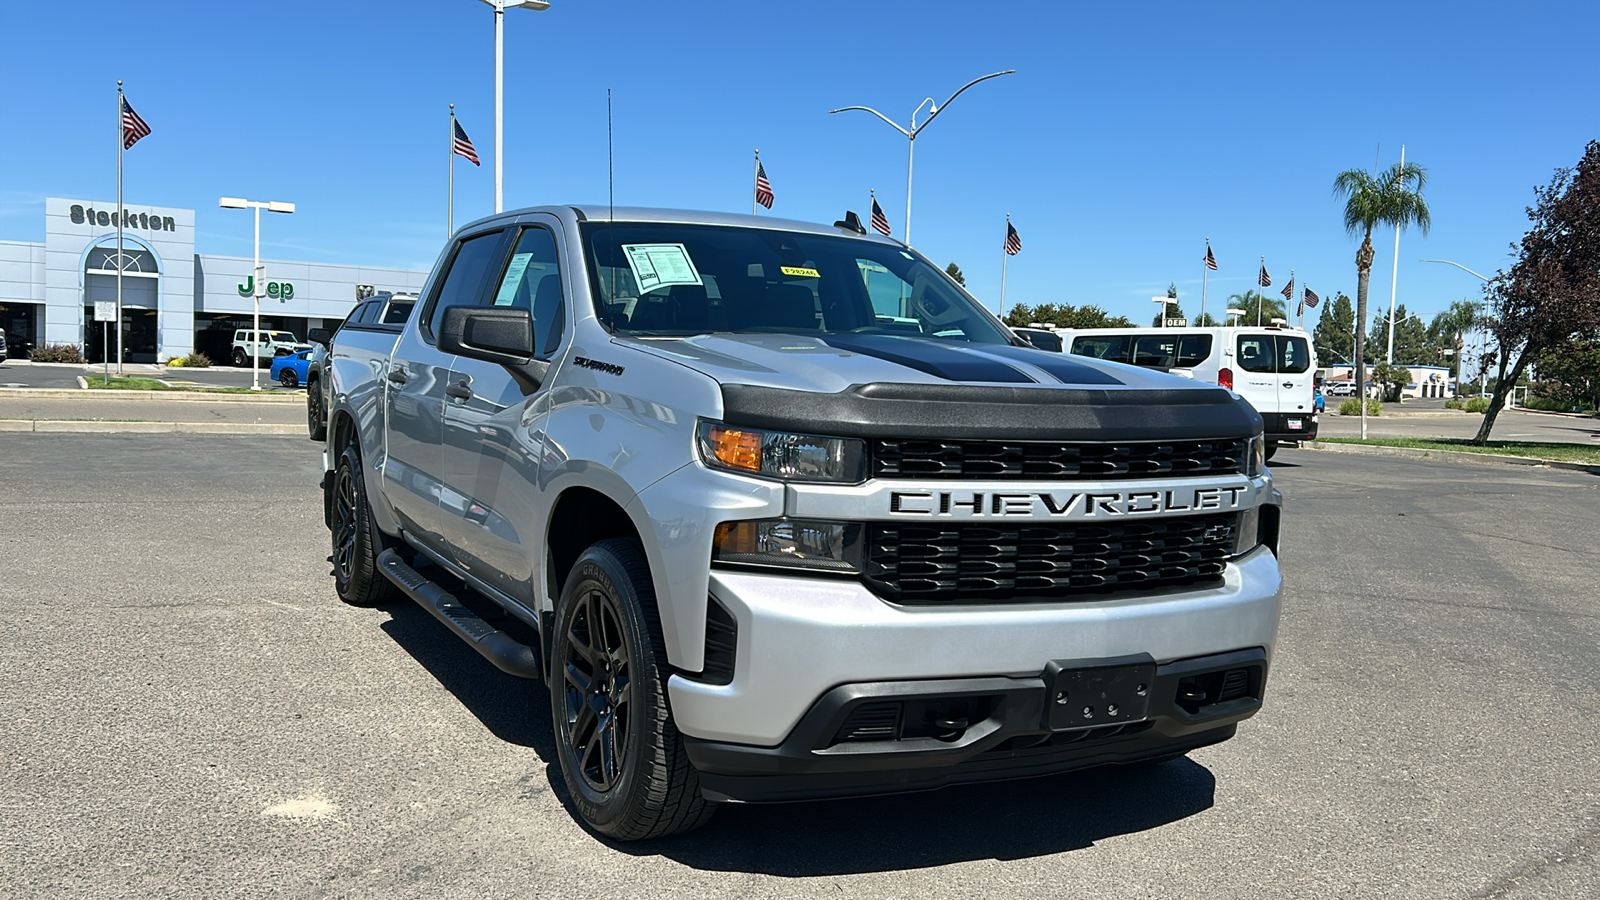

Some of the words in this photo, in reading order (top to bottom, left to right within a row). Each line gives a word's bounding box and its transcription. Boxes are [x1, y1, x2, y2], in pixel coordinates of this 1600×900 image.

[70, 204, 175, 232] Stockton
[237, 275, 294, 301] Jep
[1167, 319, 1186, 327] OEM
[573, 356, 626, 377] SILVERADO
[889, 485, 1248, 518] CHEVROLET
